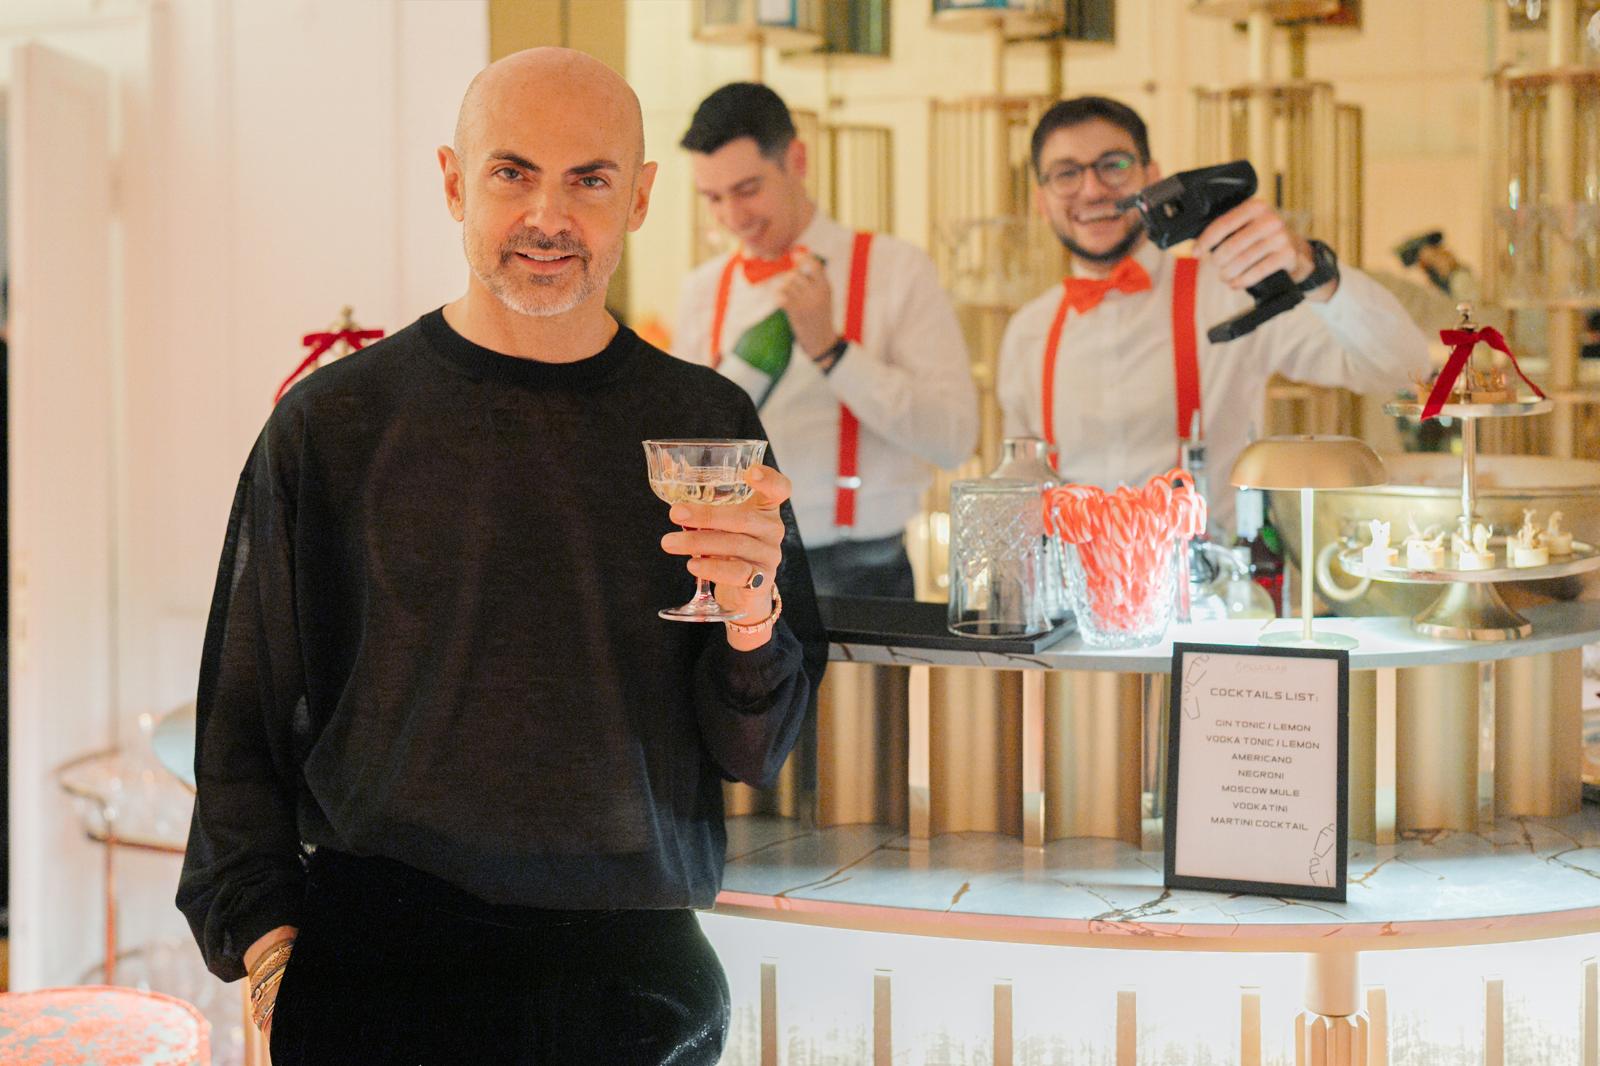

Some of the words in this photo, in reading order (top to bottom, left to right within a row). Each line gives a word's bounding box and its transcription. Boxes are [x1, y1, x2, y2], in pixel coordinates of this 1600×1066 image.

[1210, 687, 1282, 700] COCKTAILS
[1215, 719, 1233, 727] GIN
[1235, 720, 1265, 729] TONIC
[1273, 723, 1311, 732] LEMON
[1206, 735, 1240, 744] VODKA
[1243, 737, 1274, 747] TONIC
[1281, 740, 1320, 749] LEMON
[1231, 753, 1293, 764] AMERICANO
[1238, 769, 1284, 780] NEGRONI
[1221, 785, 1267, 795] MOSCOW
[1269, 789, 1300, 797] MULE
[1210, 816, 1253, 827] MARTINI
[1255, 819, 1309, 831] COCKTAIL
